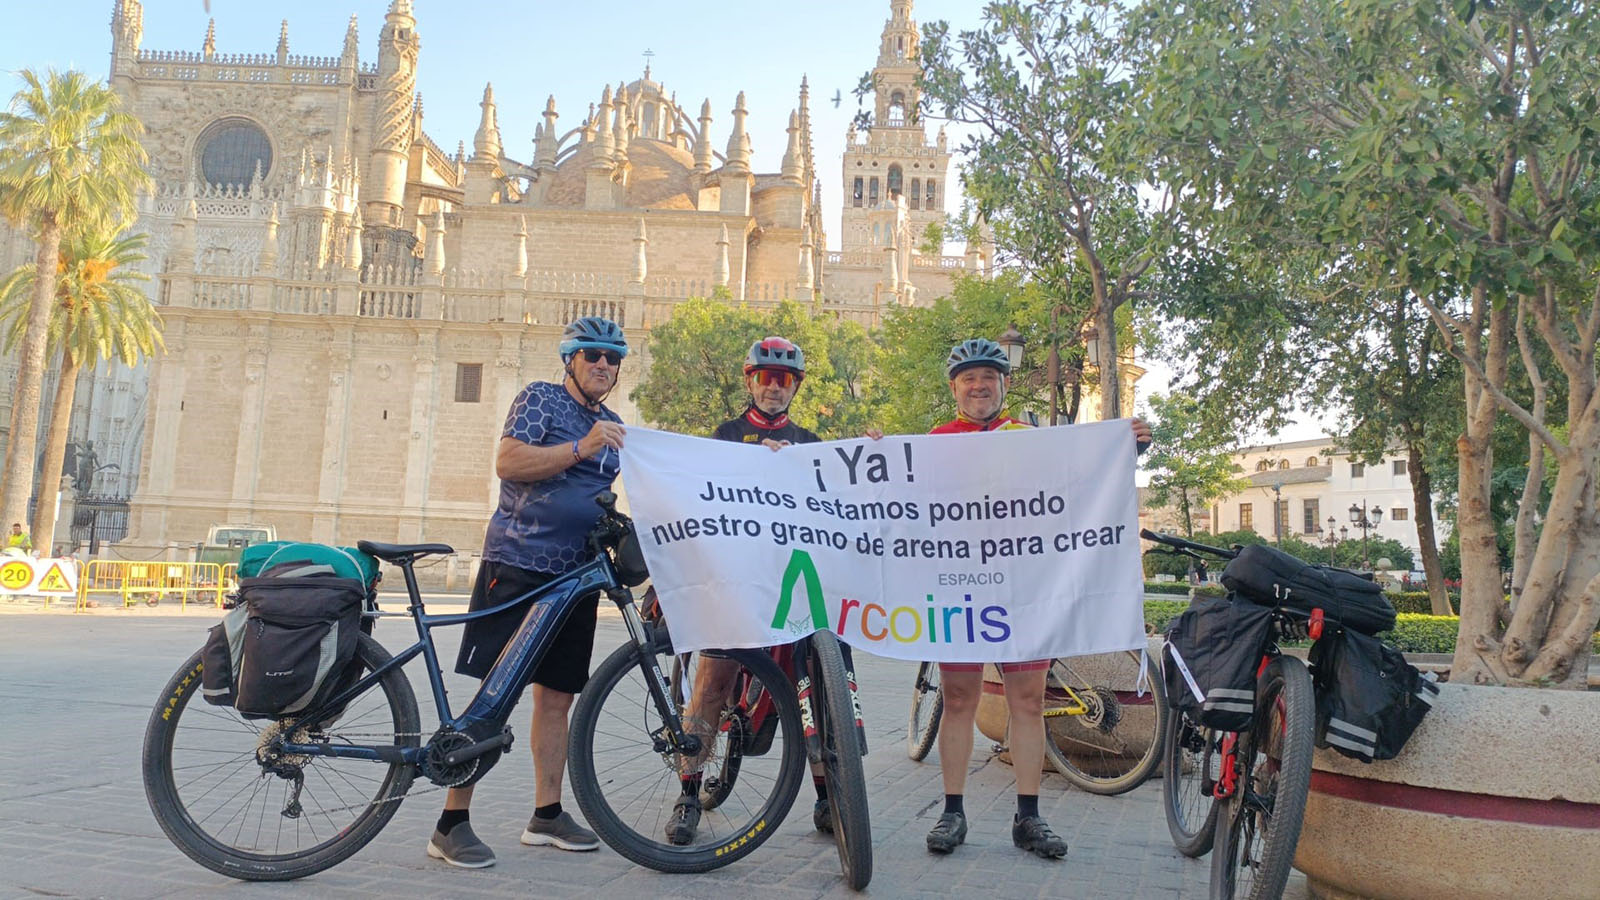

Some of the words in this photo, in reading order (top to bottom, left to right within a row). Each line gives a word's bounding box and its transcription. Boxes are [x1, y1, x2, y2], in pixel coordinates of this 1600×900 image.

[700, 481, 796, 509] Juntos
[806, 496, 919, 521] estamos
[929, 491, 1065, 527] poniendo
[652, 513, 761, 546] nuestro
[771, 521, 848, 550] grano
[856, 536, 884, 558] de
[893, 538, 970, 559] arena
[980, 533, 1044, 565] para
[1053, 525, 1125, 553] crear
[4, 568, 27, 582] 20
[938, 571, 1004, 586] ESPACIO
[771, 548, 1012, 645] Arcoiris
[162, 662, 204, 721] MAXXIS
[799, 696, 815, 732] FOX
[714, 819, 766, 857] MAXXIS
